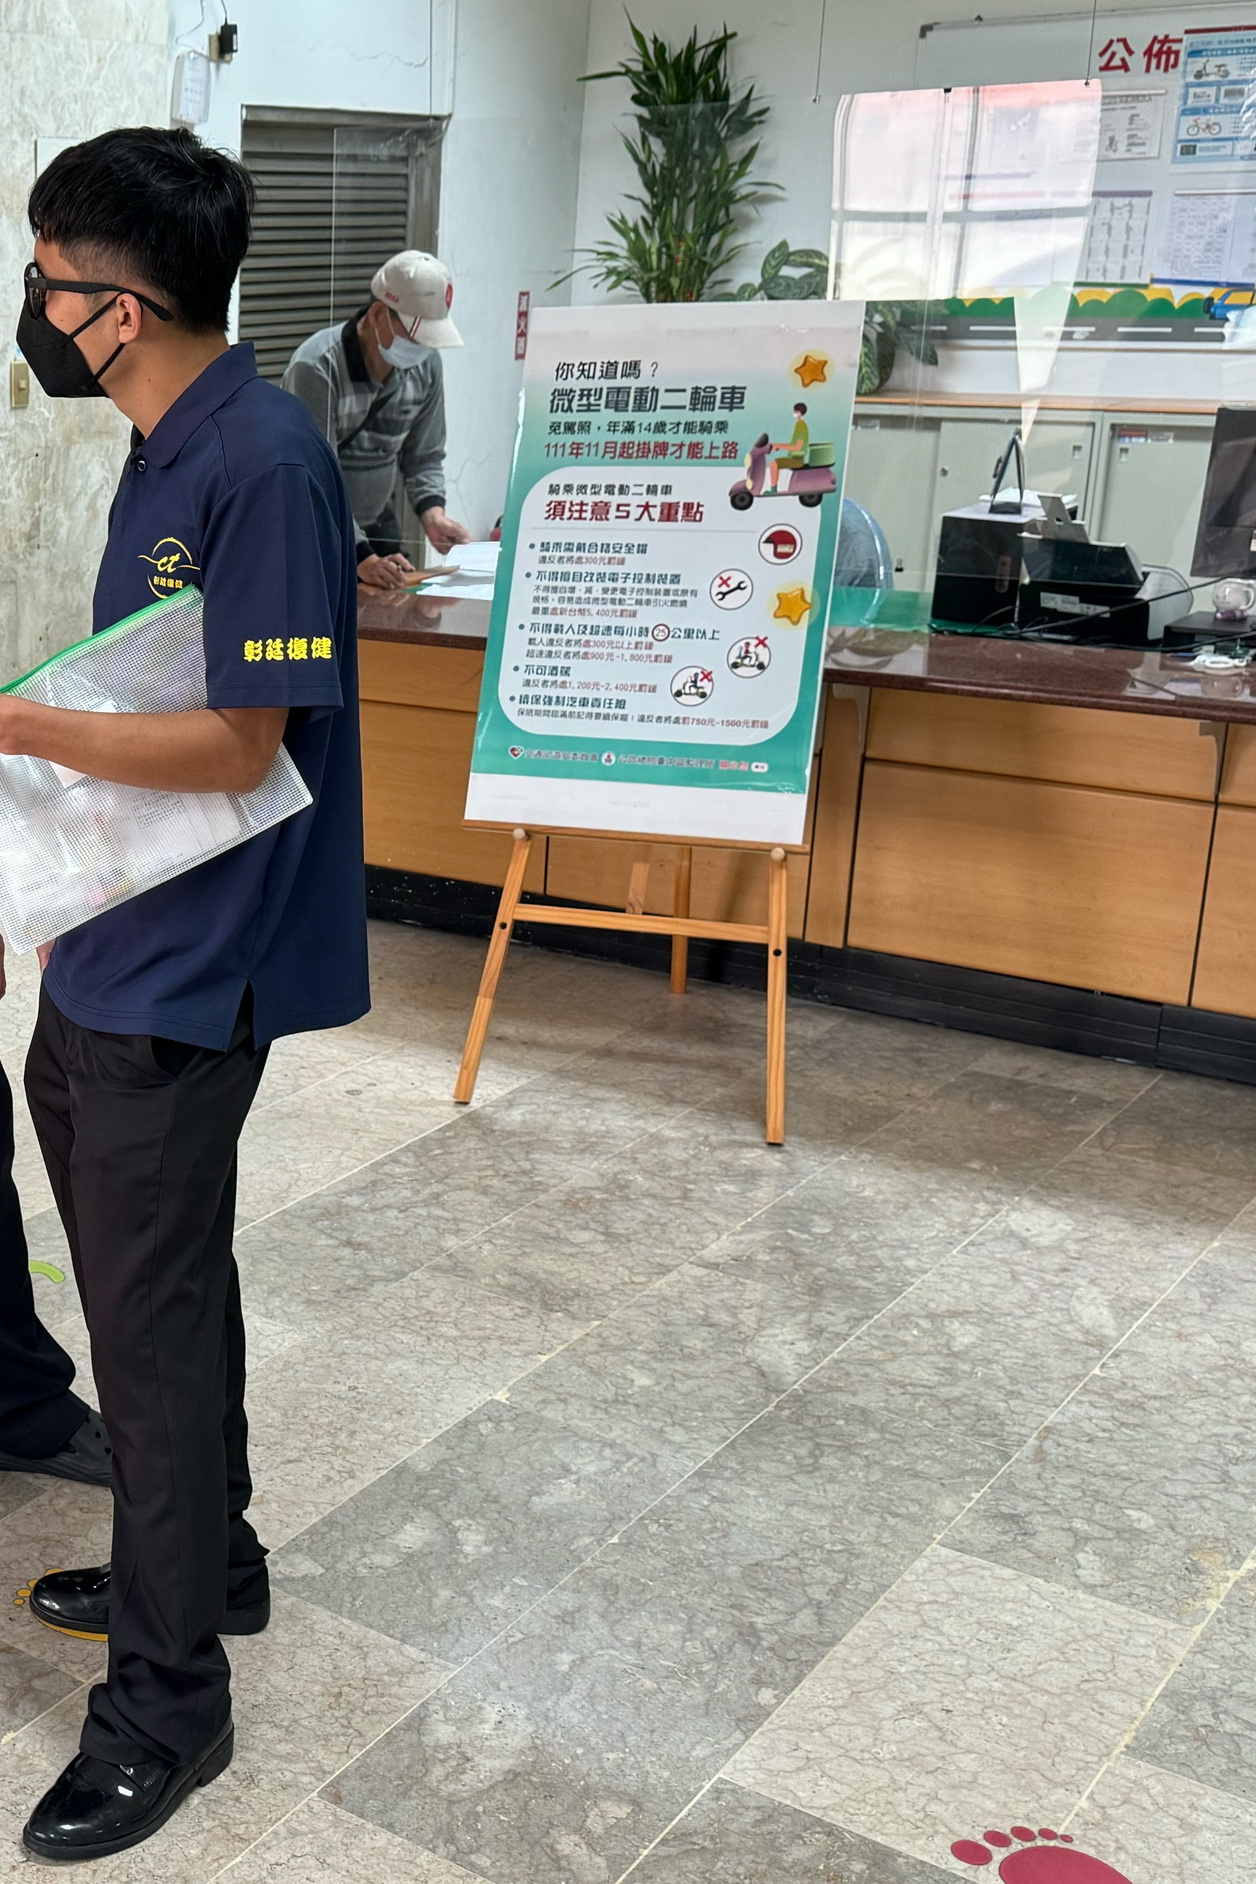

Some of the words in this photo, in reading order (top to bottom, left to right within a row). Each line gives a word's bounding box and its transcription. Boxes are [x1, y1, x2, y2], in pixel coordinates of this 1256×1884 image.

[1098, 34, 1182, 74] 公佈
[554, 359, 660, 381] 你知道嗎？
[548, 385, 747, 414] 微型電動二輪車
[544, 440, 740, 461] 111年11月起掛牌才能上路
[547, 483, 674, 497] 騎乘微型電動二輪車
[544, 500, 704, 523] 須注意5大重點
[535, 570, 682, 586] 不得擅自改裝電子控制裝置
[243, 636, 332, 663] 彰廷復健
